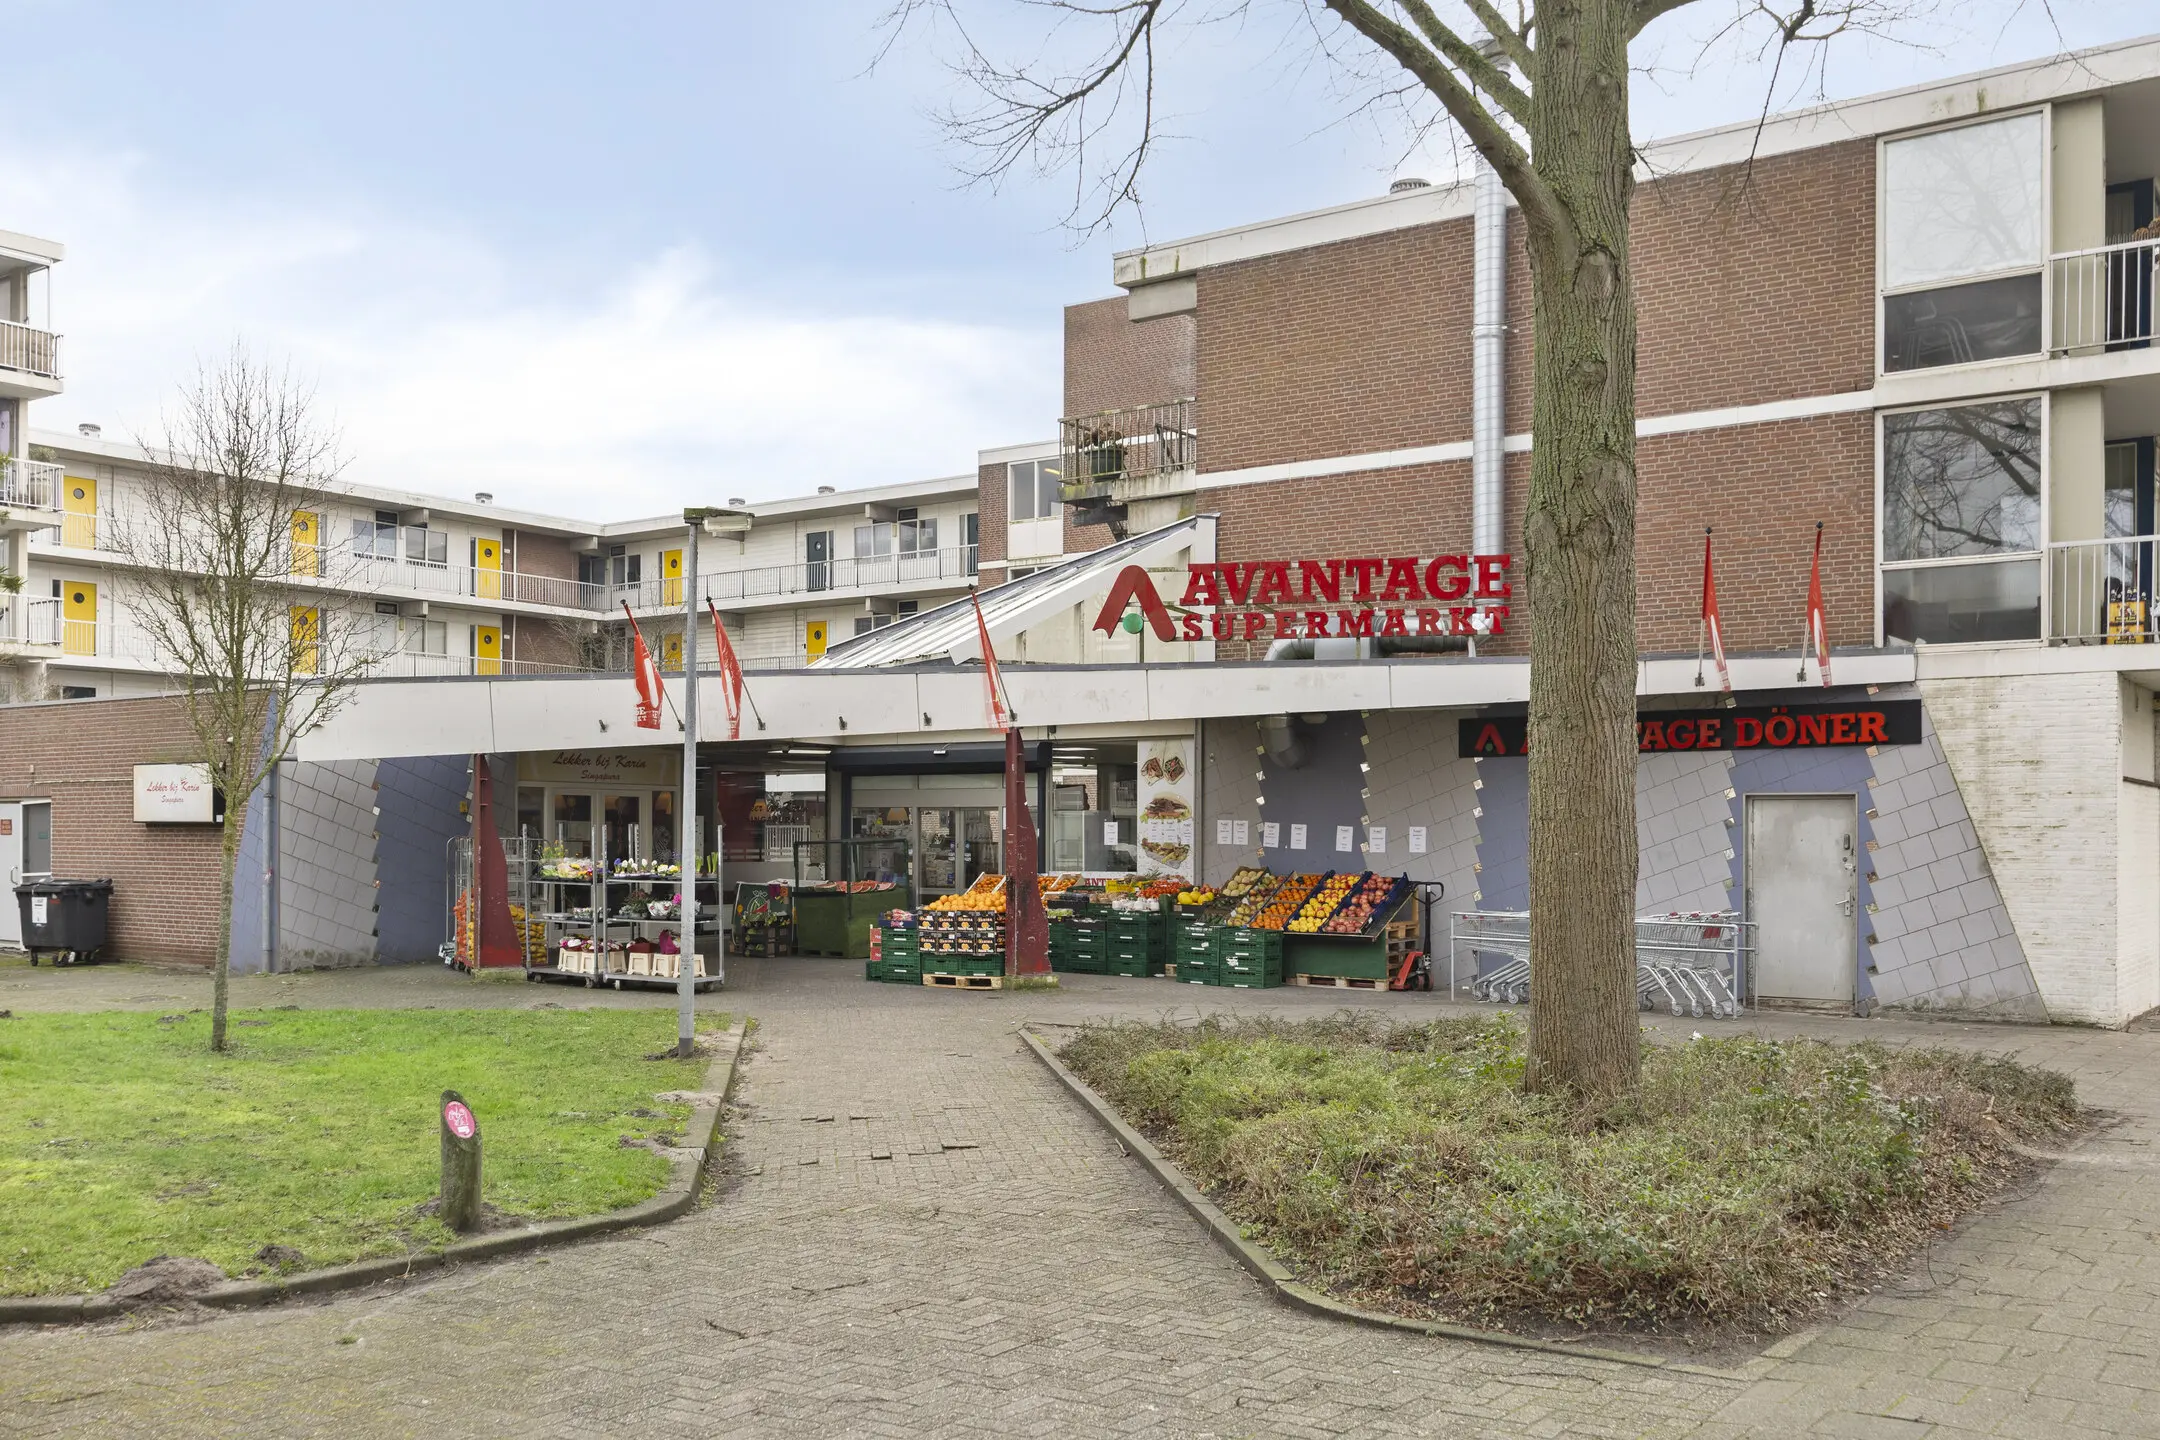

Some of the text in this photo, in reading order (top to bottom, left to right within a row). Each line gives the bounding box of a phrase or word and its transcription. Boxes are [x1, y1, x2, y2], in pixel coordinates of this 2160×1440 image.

[1179, 554, 1512, 606] AVANTAGE
[1182, 605, 1511, 642] SUPERMARKT
[1733, 706, 1889, 748] DÖNER
[552, 751, 648, 770] Lekker bij Karin
[146, 781, 168, 792] Lekker
